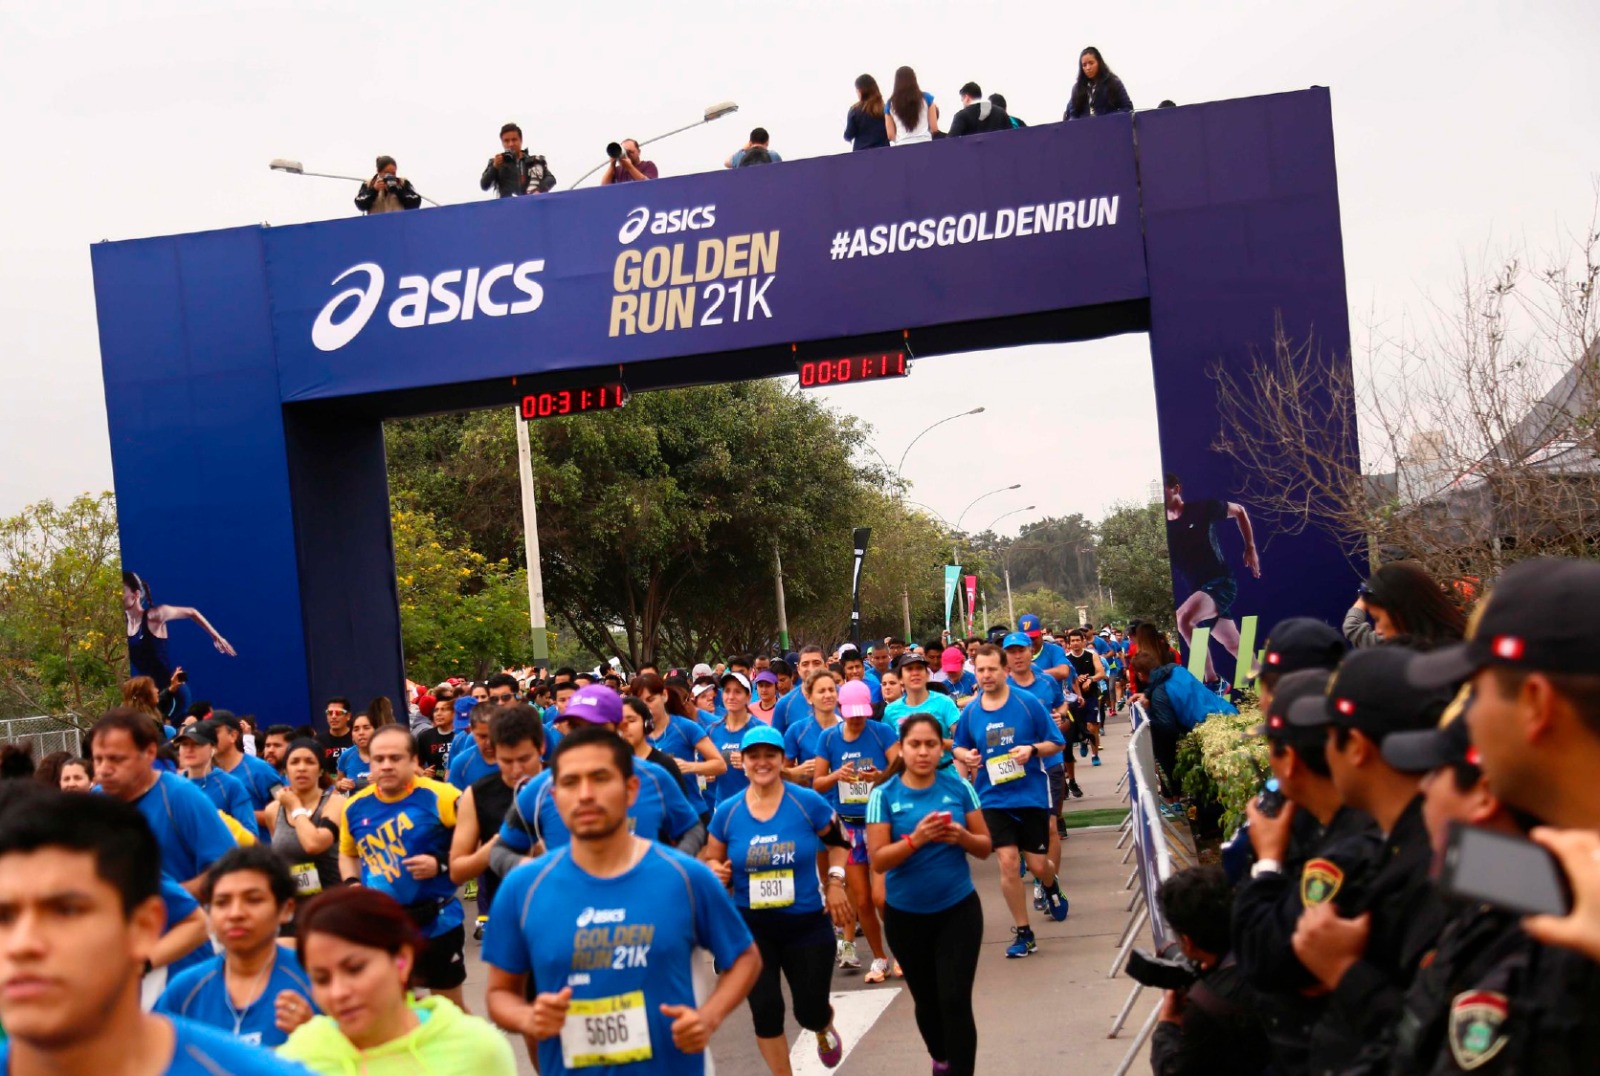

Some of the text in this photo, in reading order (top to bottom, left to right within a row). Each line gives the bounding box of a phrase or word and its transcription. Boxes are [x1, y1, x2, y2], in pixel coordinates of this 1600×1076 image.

[829, 195, 1120, 261] #ASICSGOLDENRUN
[613, 230, 780, 293] GOLDEN
[608, 275, 776, 338] RUN 21K
[801, 353, 904, 387] 00:01:11
[521, 385, 624, 419] 00:31:11
[1000, 735, 1015, 746] 21K
[998, 760, 1016, 775] 5261
[771, 851, 796, 866] 21K
[760, 880, 783, 897] 5831
[573, 924, 656, 950] GOLDEN
[572, 944, 651, 971] RUN 21K
[585, 1014, 629, 1046] 5666
